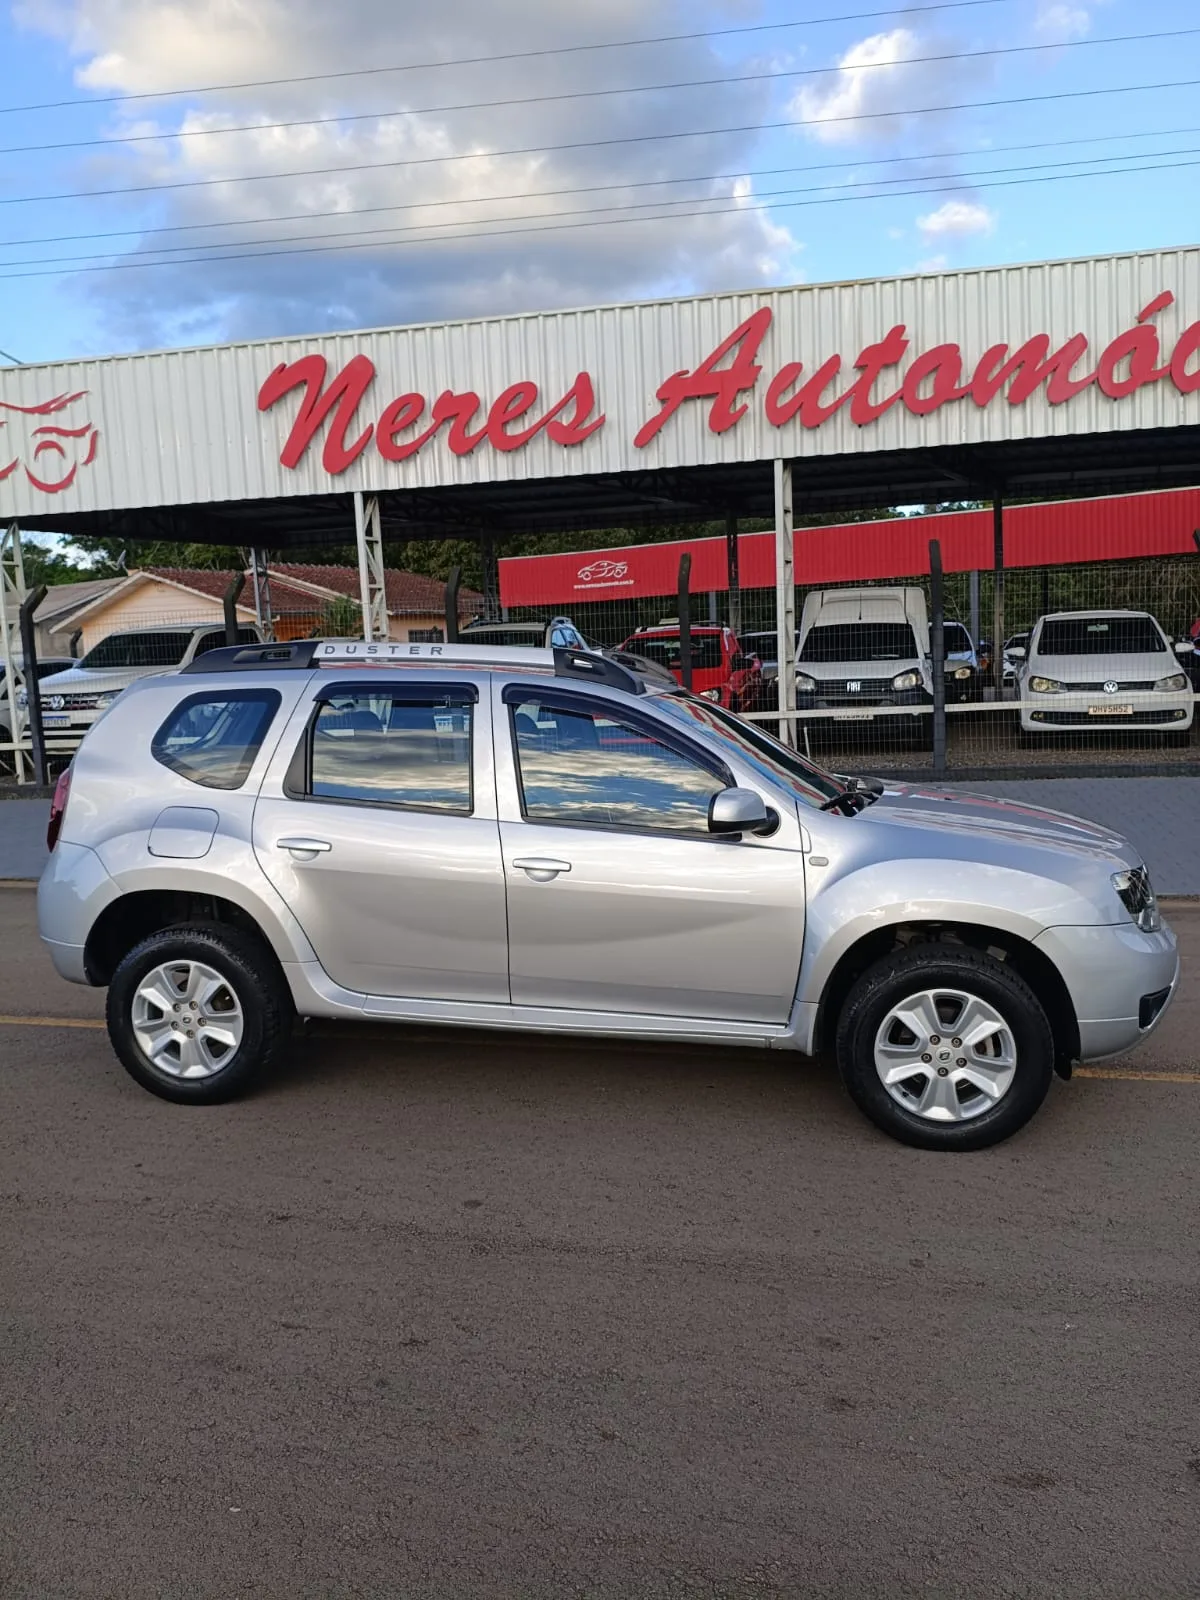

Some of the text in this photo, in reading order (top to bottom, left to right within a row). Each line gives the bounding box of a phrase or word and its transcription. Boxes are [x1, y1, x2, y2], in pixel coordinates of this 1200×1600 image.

[257, 354, 605, 475] Neres
[324, 645, 443, 655] DUSTER
[846, 681, 861, 692] FIAT
